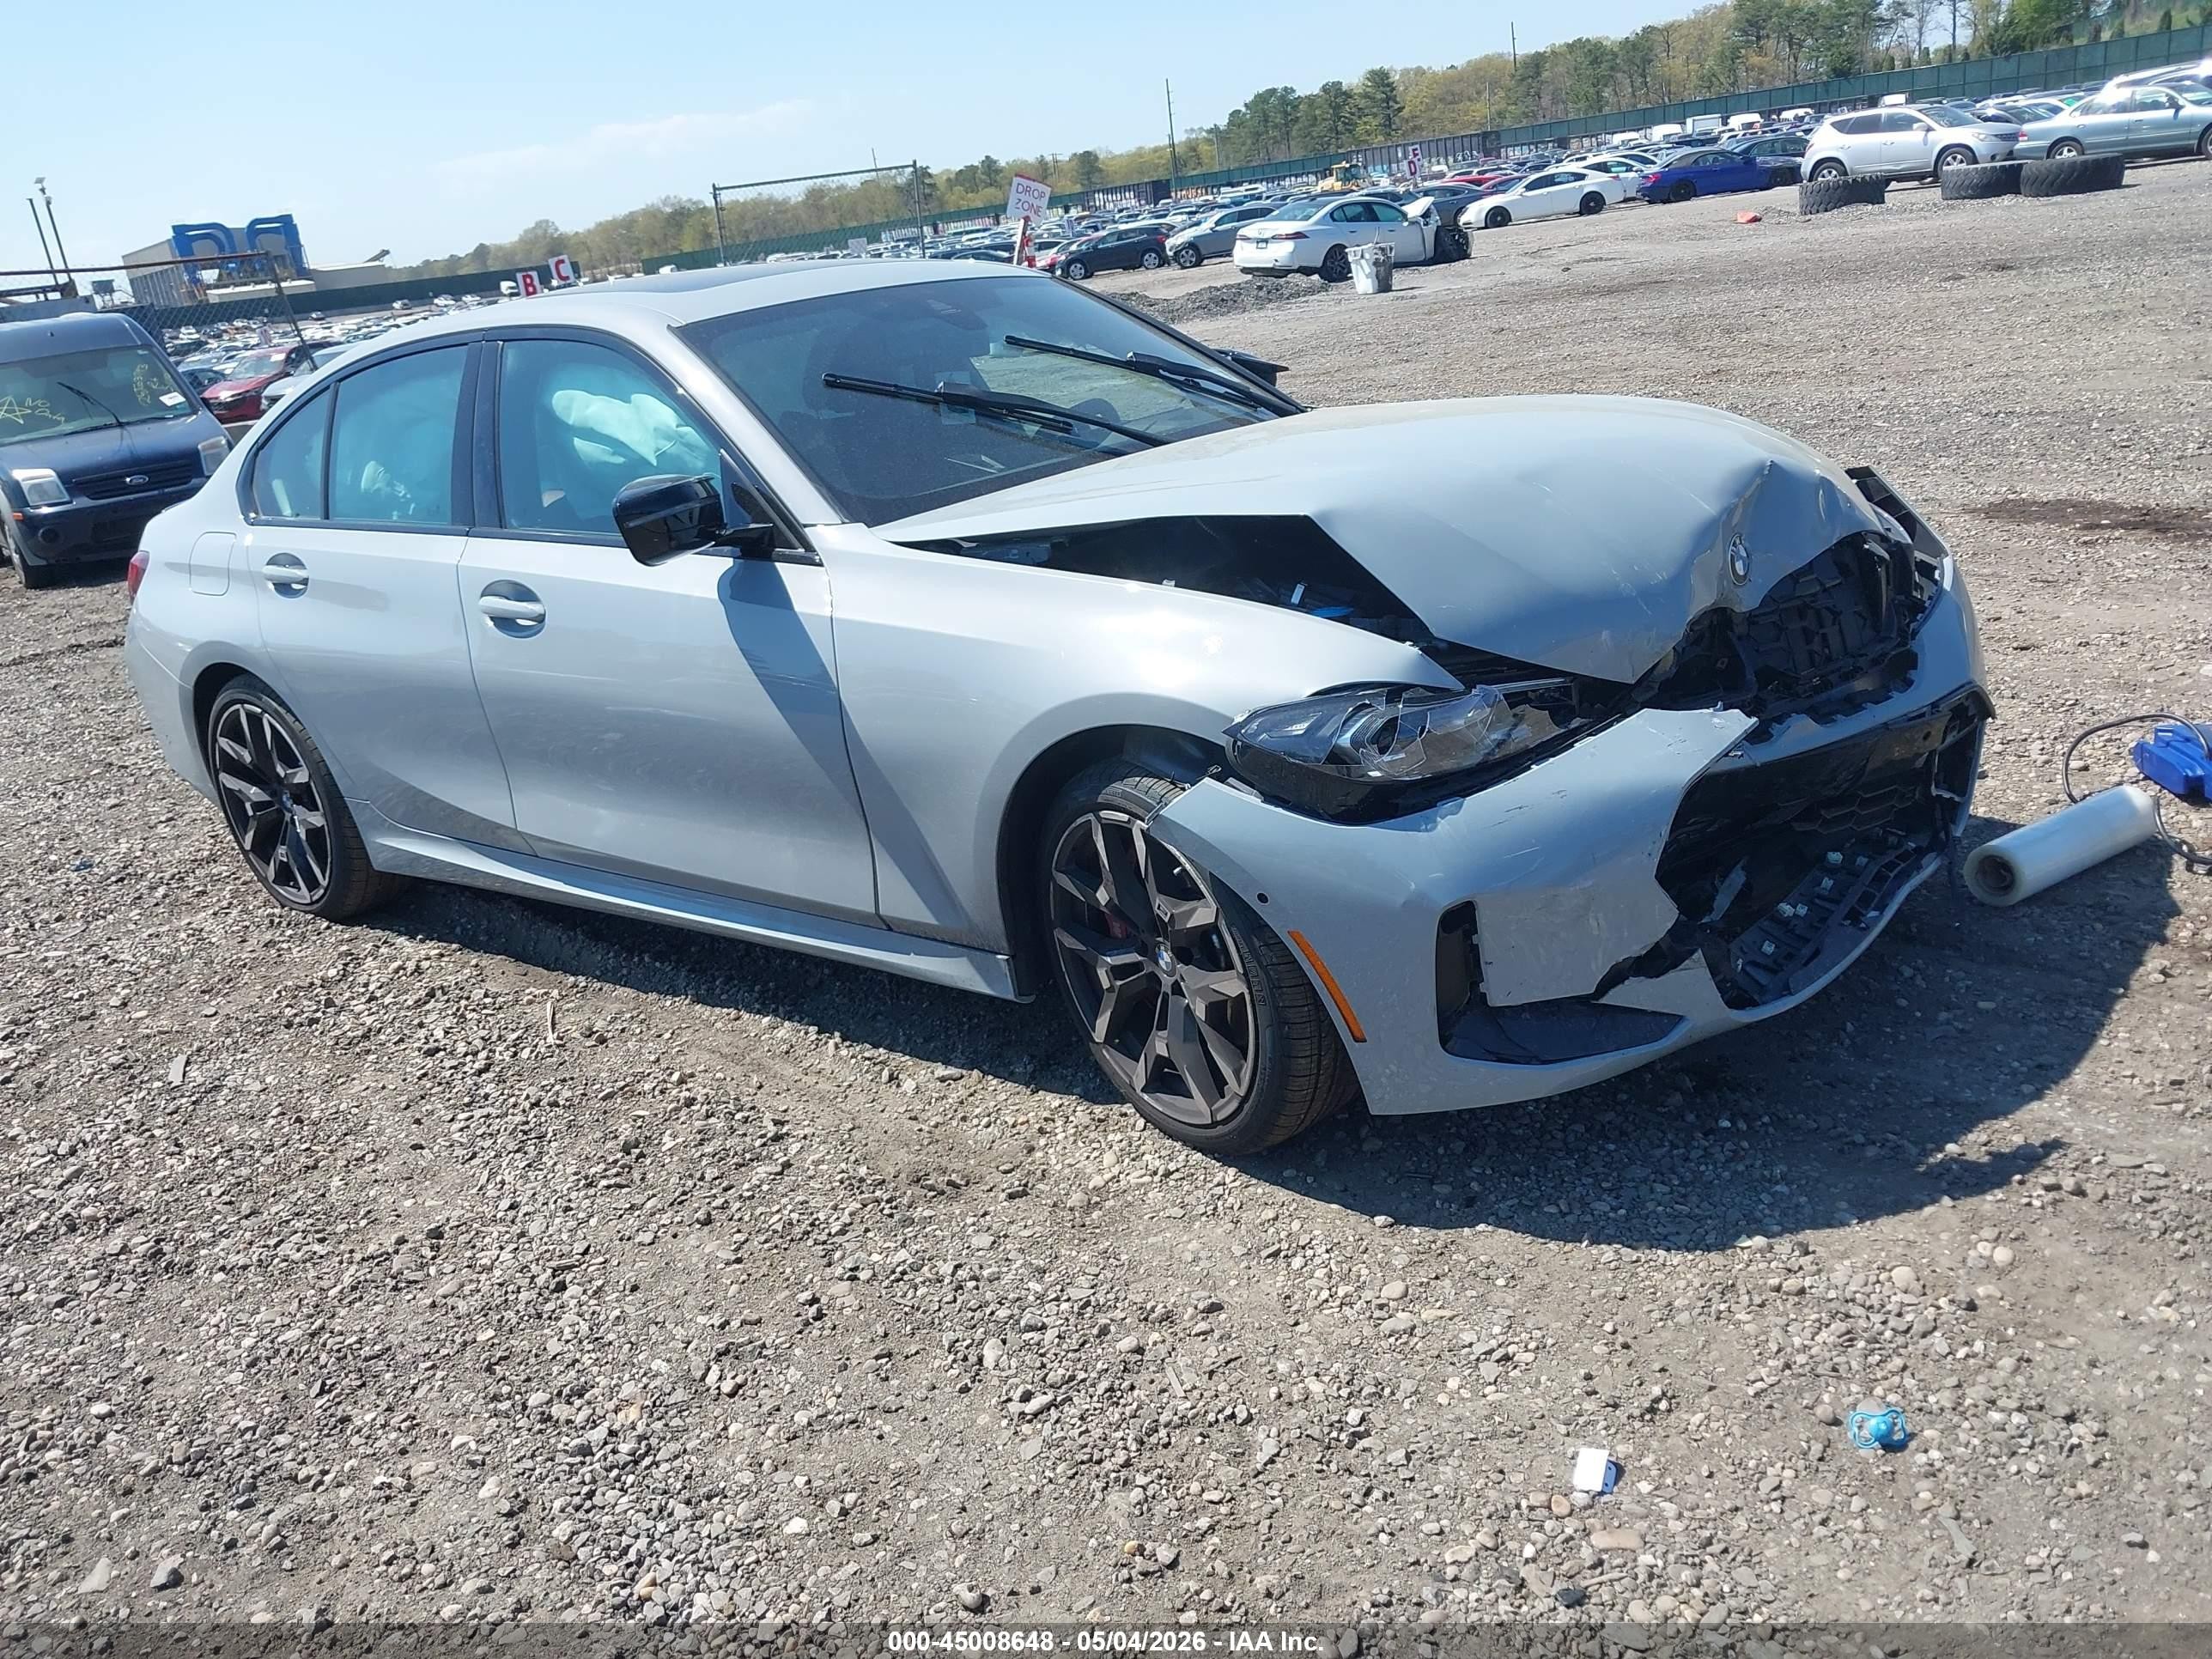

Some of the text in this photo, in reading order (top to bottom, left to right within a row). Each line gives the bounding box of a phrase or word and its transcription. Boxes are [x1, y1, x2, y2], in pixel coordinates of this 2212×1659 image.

[1016, 183, 1046, 200] DROP
[1015, 198, 1043, 217] ZONE
[555, 258, 570, 282] C
[521, 273, 538, 296] B
